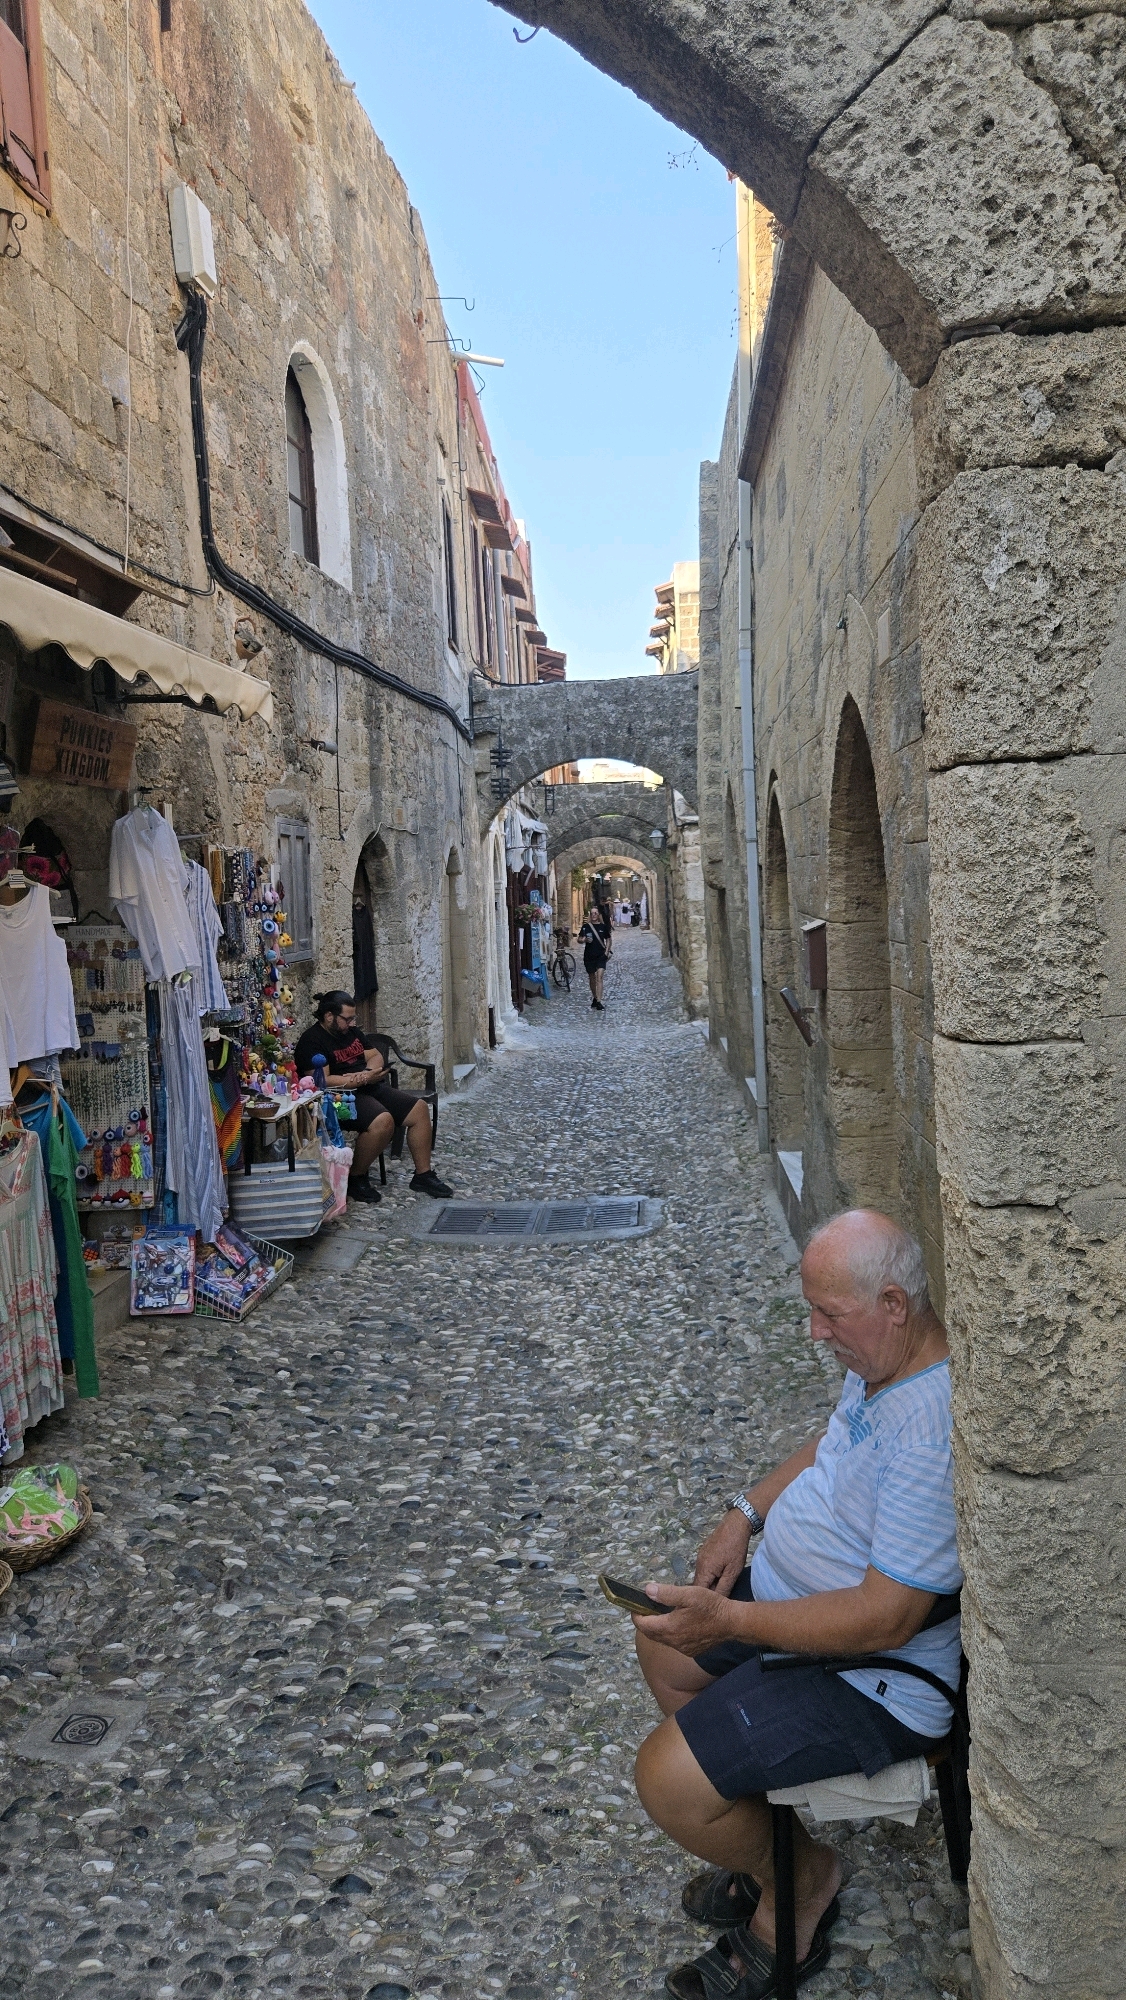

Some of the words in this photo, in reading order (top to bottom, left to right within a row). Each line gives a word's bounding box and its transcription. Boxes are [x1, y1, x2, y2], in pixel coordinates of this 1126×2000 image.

[60, 714, 114, 755] PUNKIES
[55, 746, 110, 782] KINGDOM
[75, 926, 114, 937] HANDMADE
